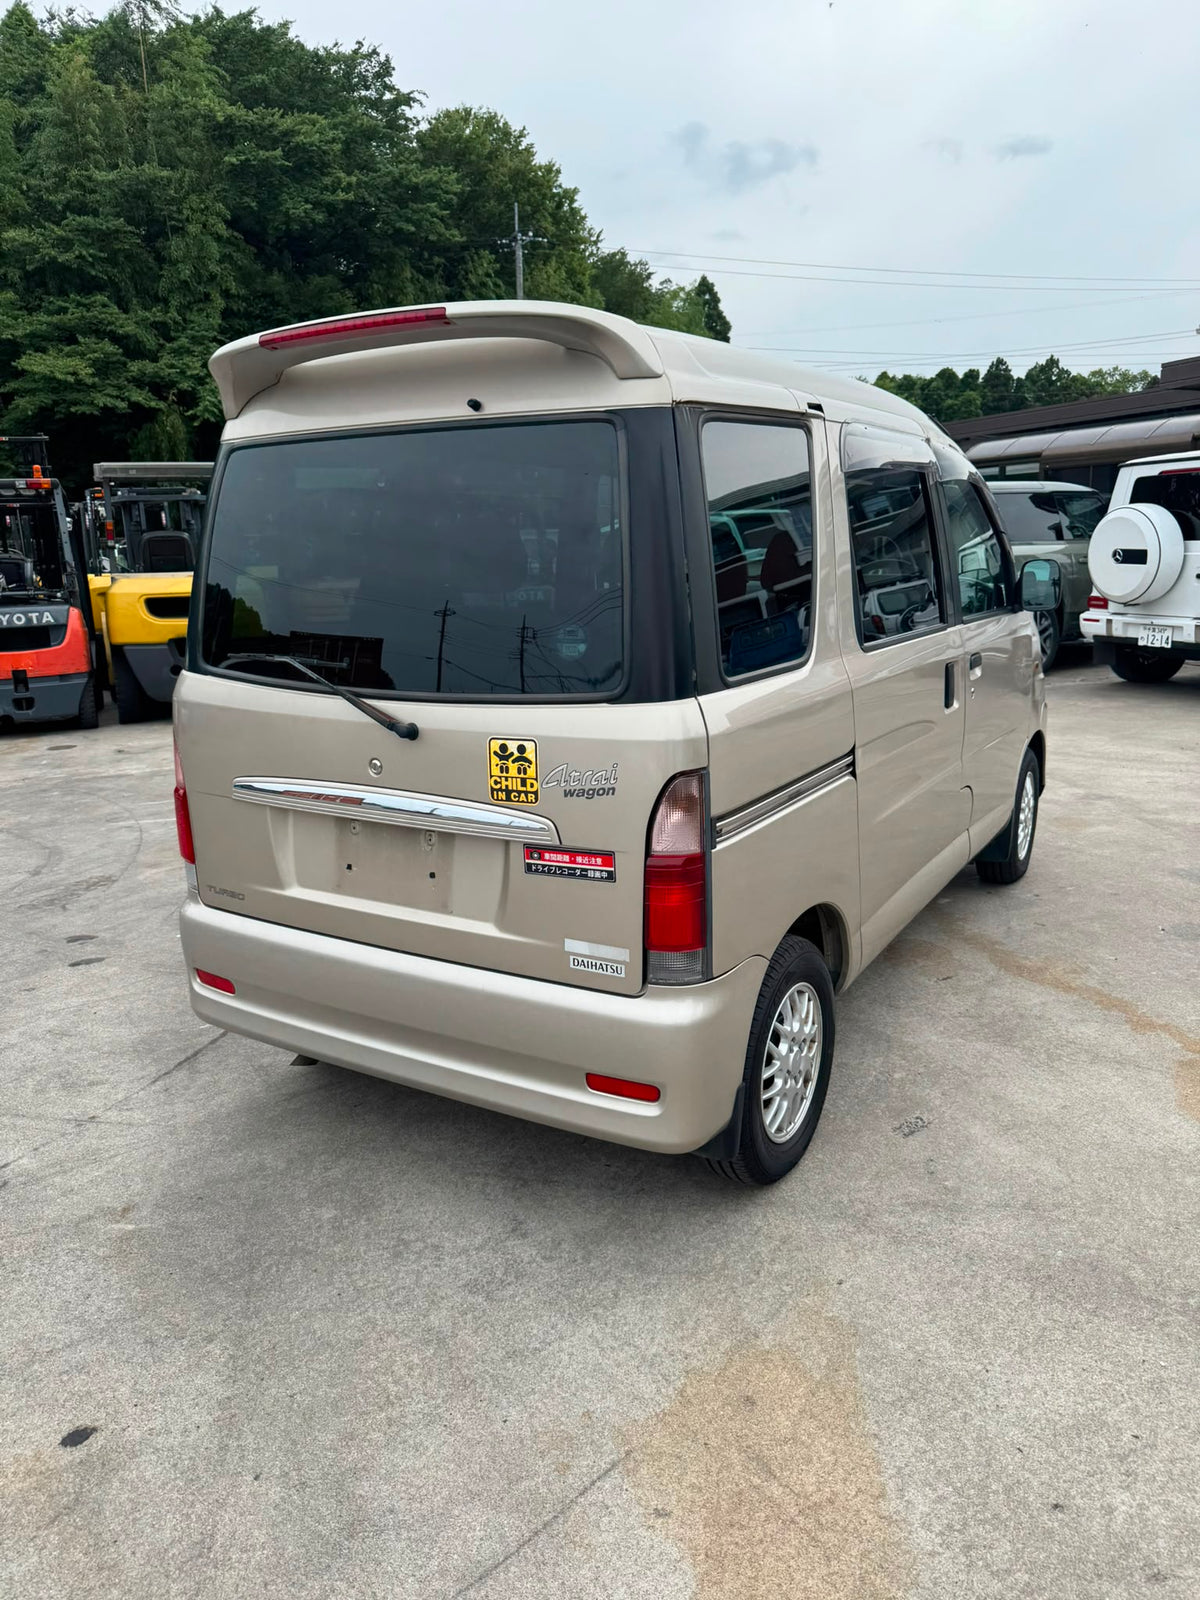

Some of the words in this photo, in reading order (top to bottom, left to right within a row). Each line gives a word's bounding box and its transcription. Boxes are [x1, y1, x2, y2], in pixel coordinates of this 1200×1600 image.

[541, 762, 618, 788] Atrai
[490, 776, 538, 792] CHILD
[493, 791, 506, 801] IN
[510, 792, 536, 802] CAR
[563, 786, 616, 799] wagon
[572, 957, 623, 975] DAIHATSU
